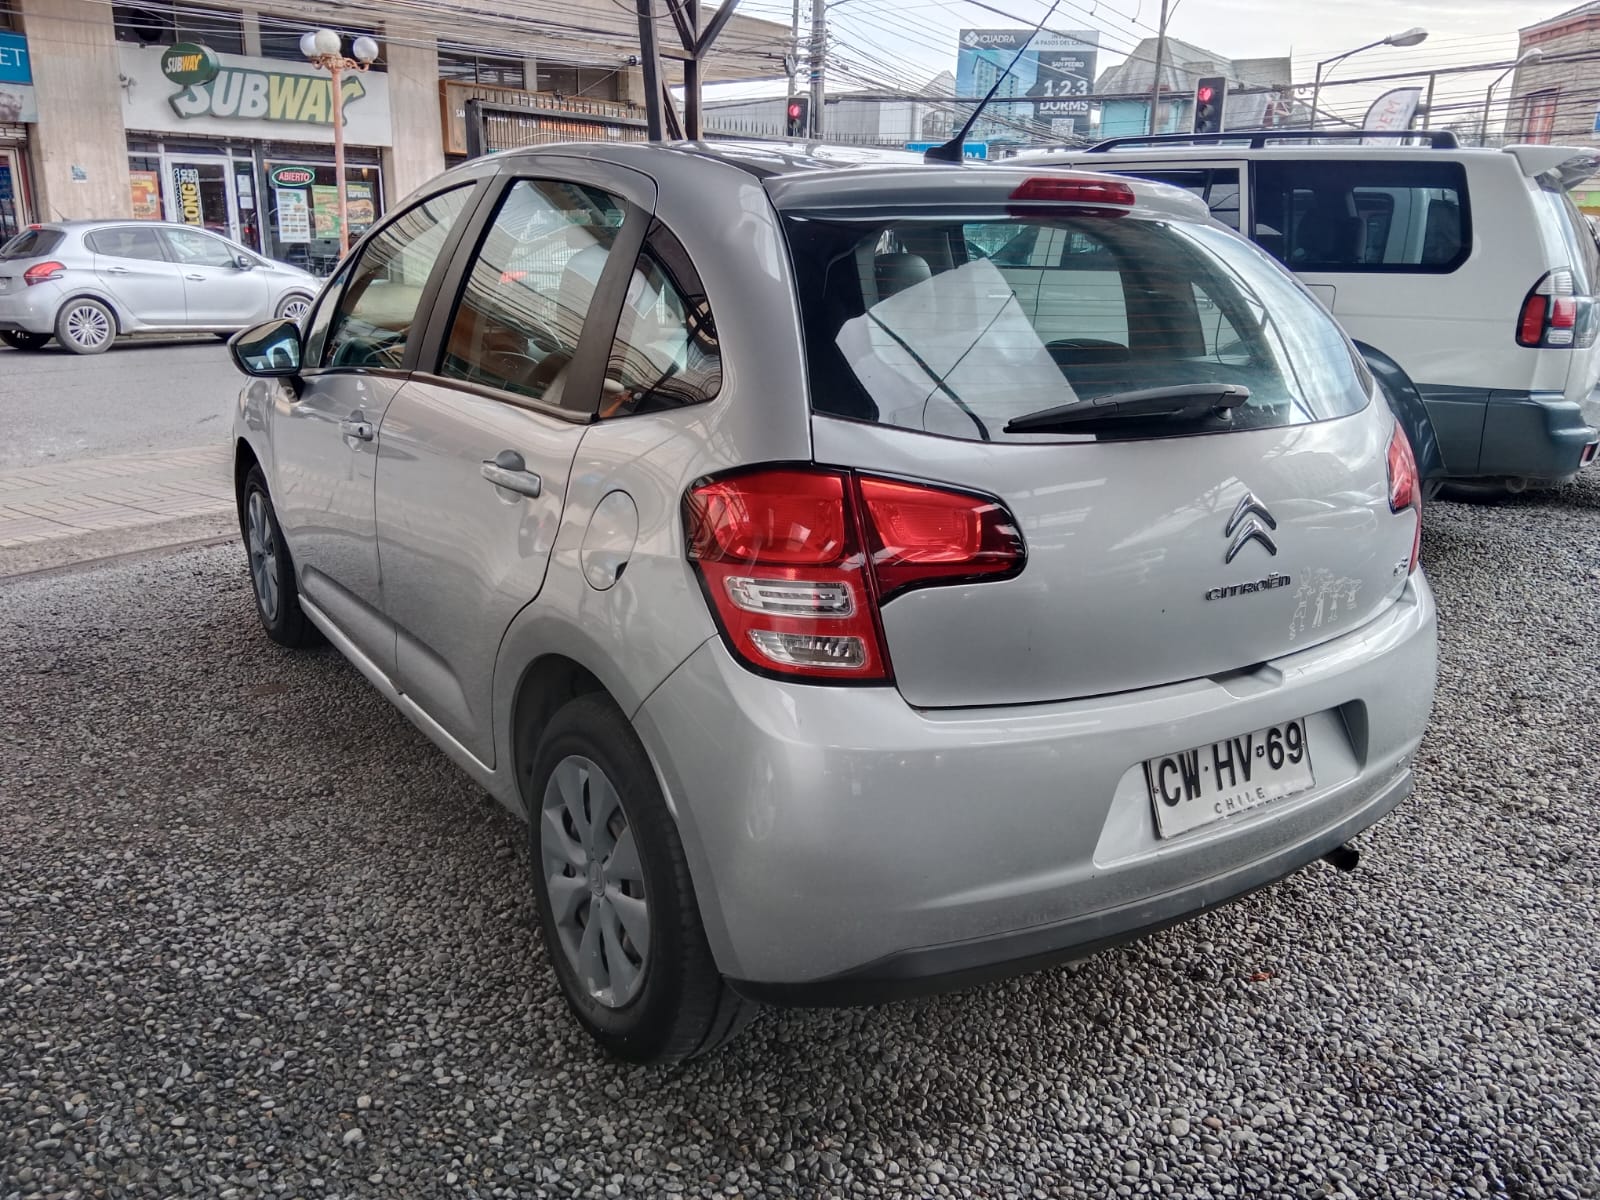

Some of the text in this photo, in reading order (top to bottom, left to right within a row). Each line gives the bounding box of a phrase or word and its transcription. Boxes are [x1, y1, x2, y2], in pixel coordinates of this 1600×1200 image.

[165, 54, 203, 74] SUBWAY
[173, 70, 365, 124] SUBWAY
[1040, 100, 1089, 111] DORMS
[278, 171, 310, 182] ABIERTO
[1213, 786, 1265, 814] CHILE
